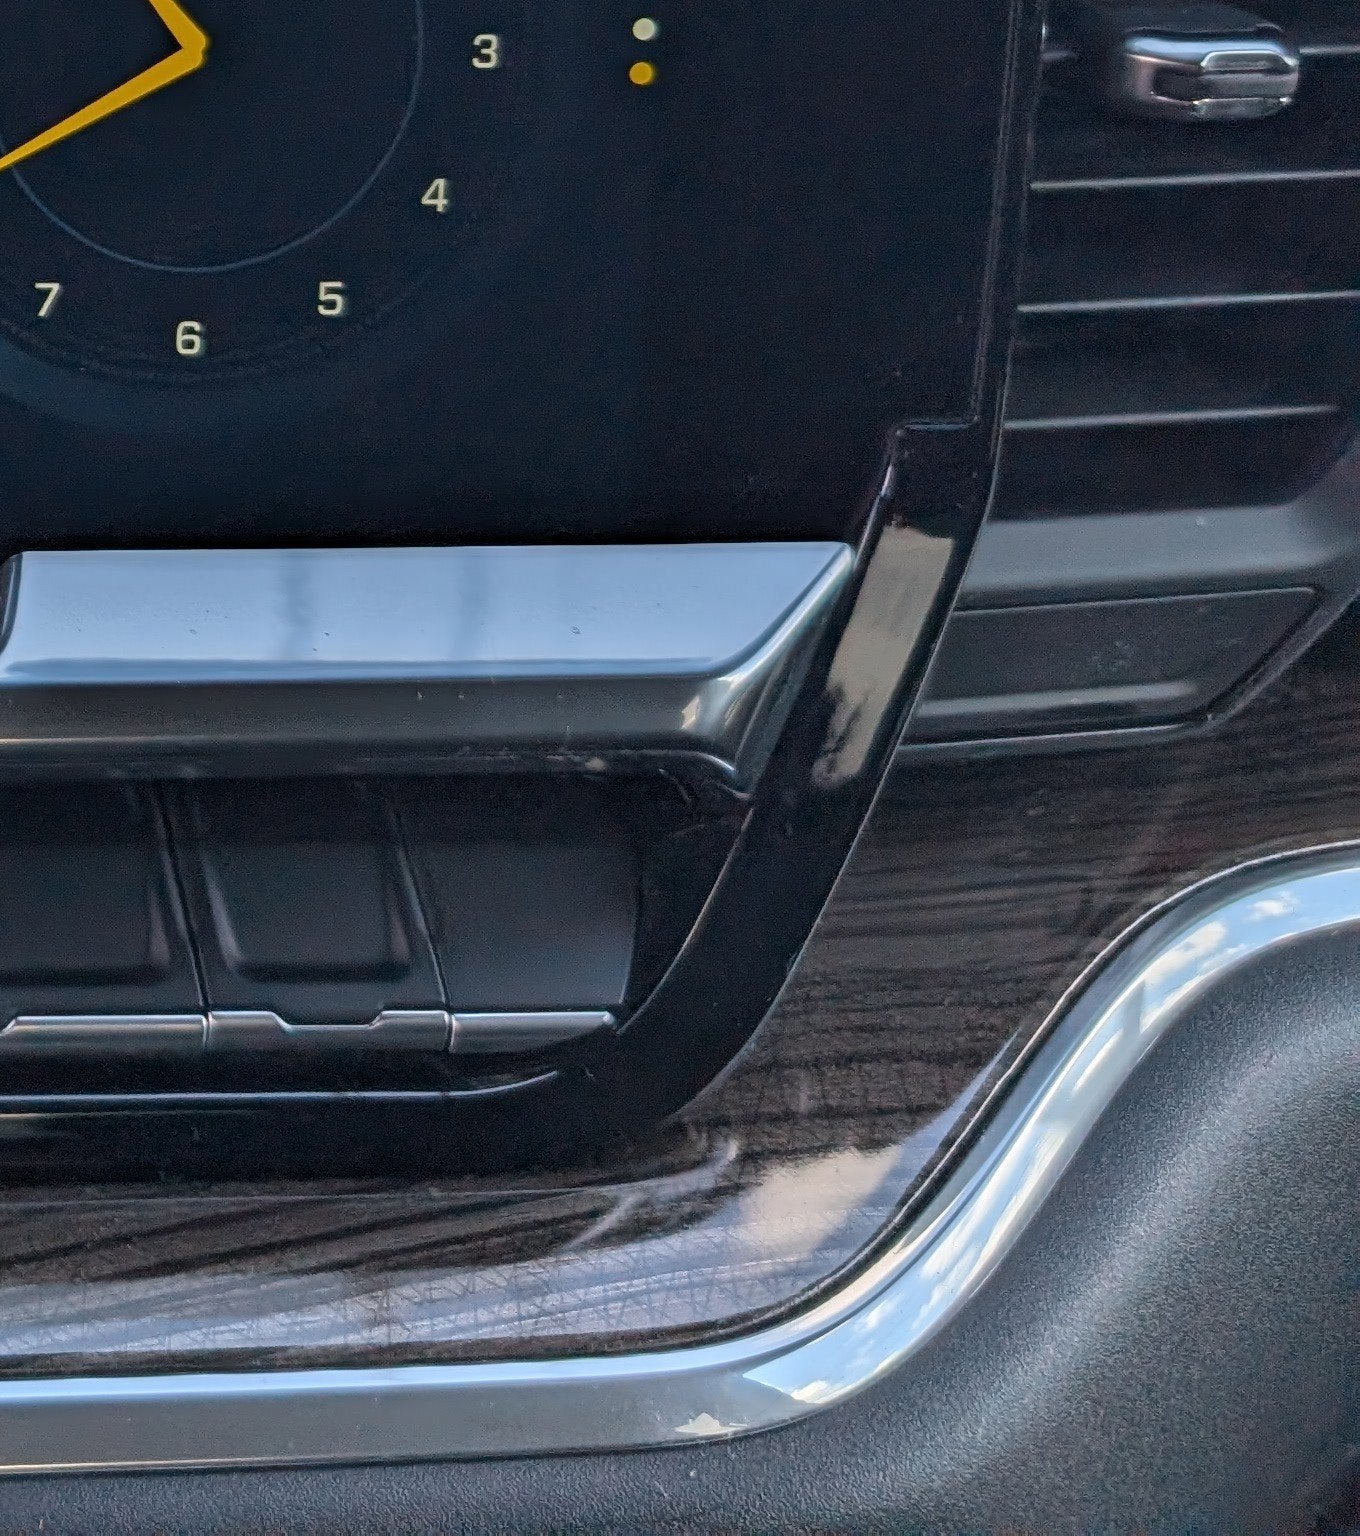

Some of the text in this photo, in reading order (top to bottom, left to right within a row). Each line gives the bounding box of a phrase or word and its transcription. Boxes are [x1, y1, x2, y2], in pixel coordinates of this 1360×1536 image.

[472, 33, 499, 69] 3
[420, 178, 449, 213] 4
[34, 282, 63, 317] 7
[317, 281, 345, 316] 5
[175, 320, 202, 356] 6
